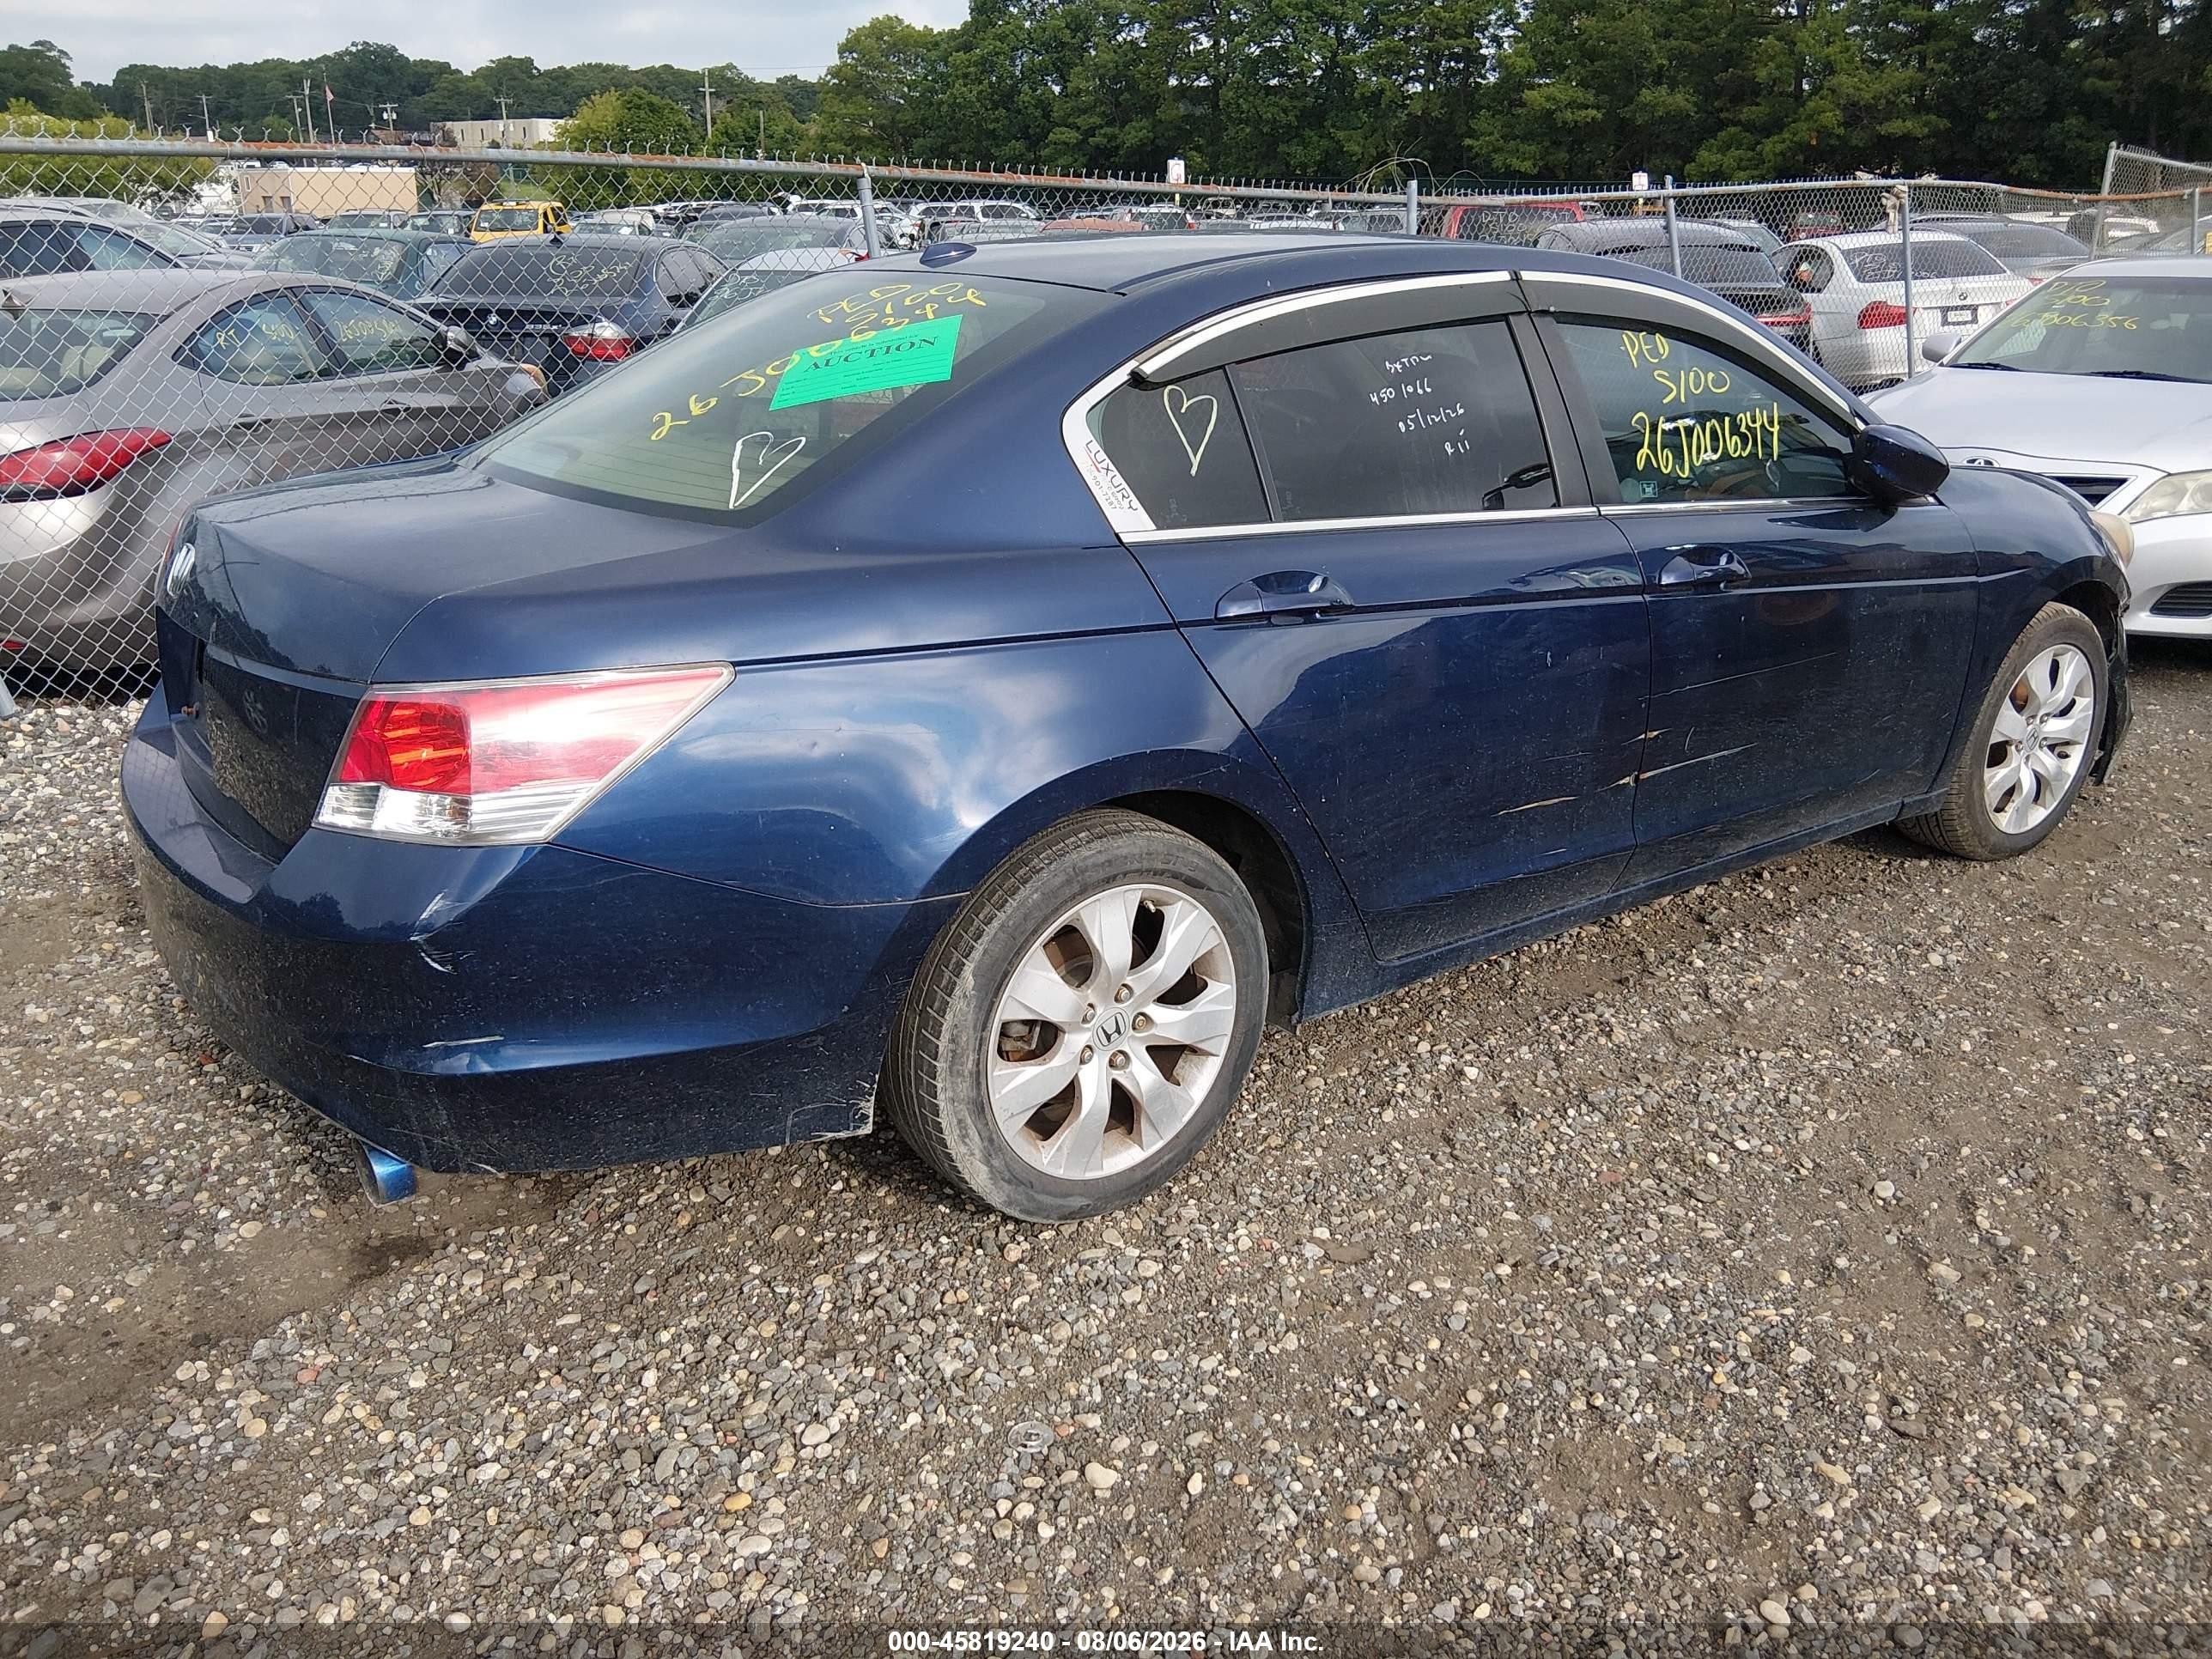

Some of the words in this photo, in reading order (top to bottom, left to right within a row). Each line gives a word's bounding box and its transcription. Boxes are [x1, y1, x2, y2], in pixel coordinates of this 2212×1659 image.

[807, 285, 911, 323] PED
[804, 335, 939, 373] AUCTION
[1621, 331, 1669, 368] PED
[1398, 403, 1465, 433] 05/12/26
[1632, 402, 1779, 478] 26J006344
[1085, 439, 1139, 512] LUXURY
